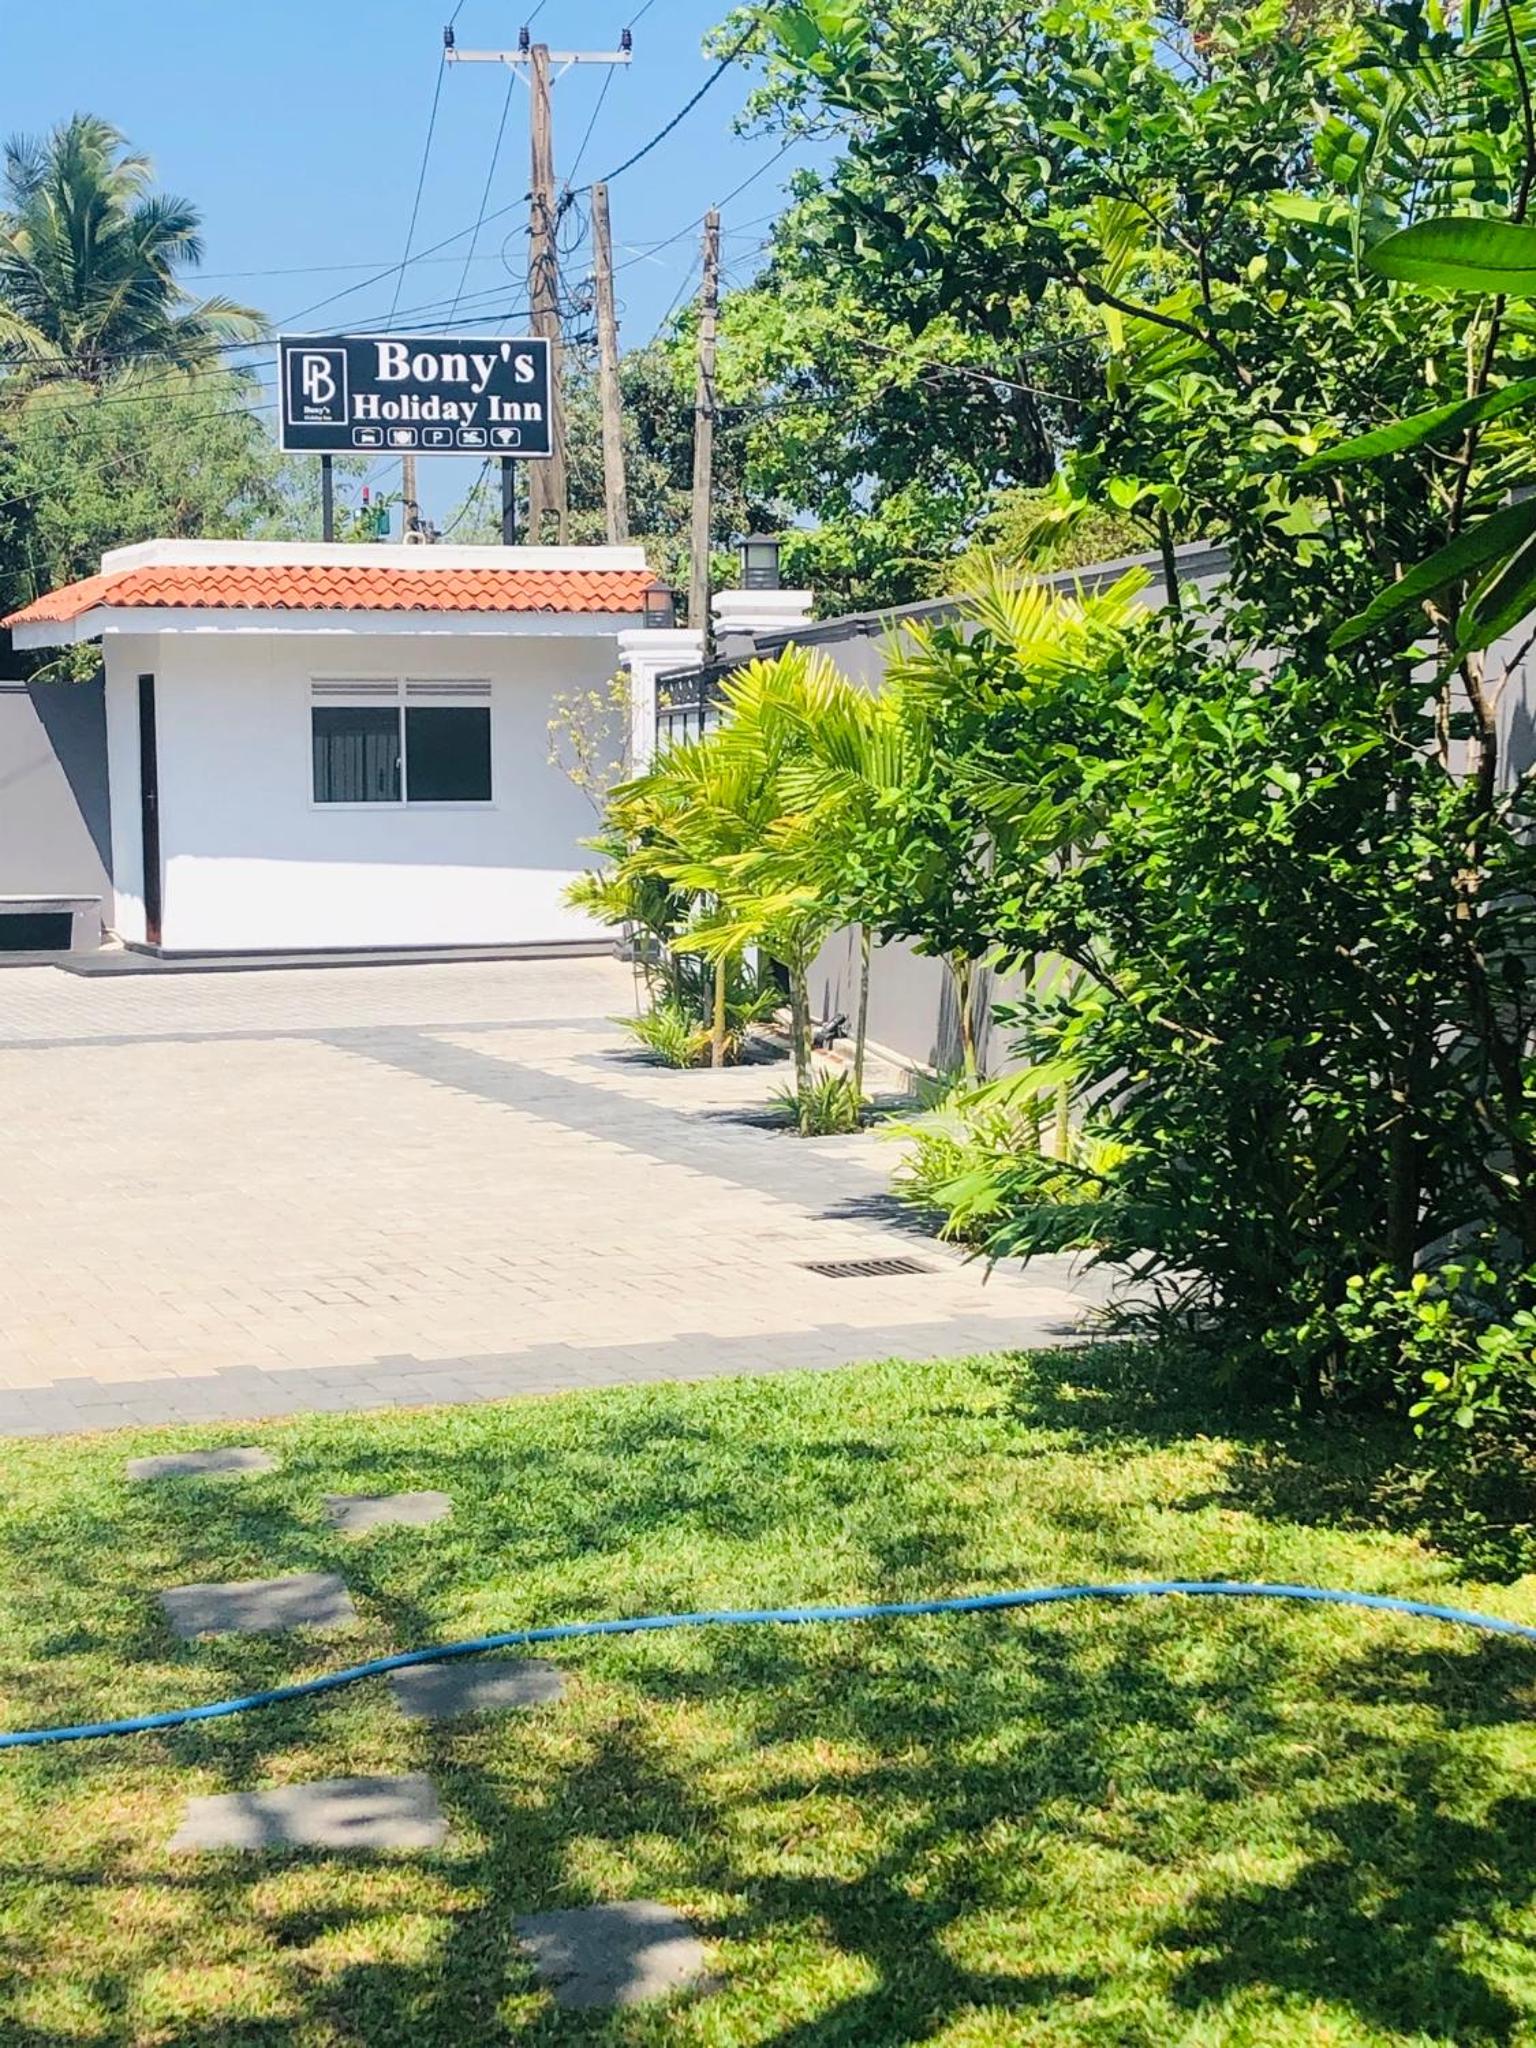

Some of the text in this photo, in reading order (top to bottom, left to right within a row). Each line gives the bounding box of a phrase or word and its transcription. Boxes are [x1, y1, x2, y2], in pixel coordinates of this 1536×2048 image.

[374, 342, 535, 394] Bony's
[352, 394, 542, 427] Holiday Inn
[432, 431, 443, 443] P
